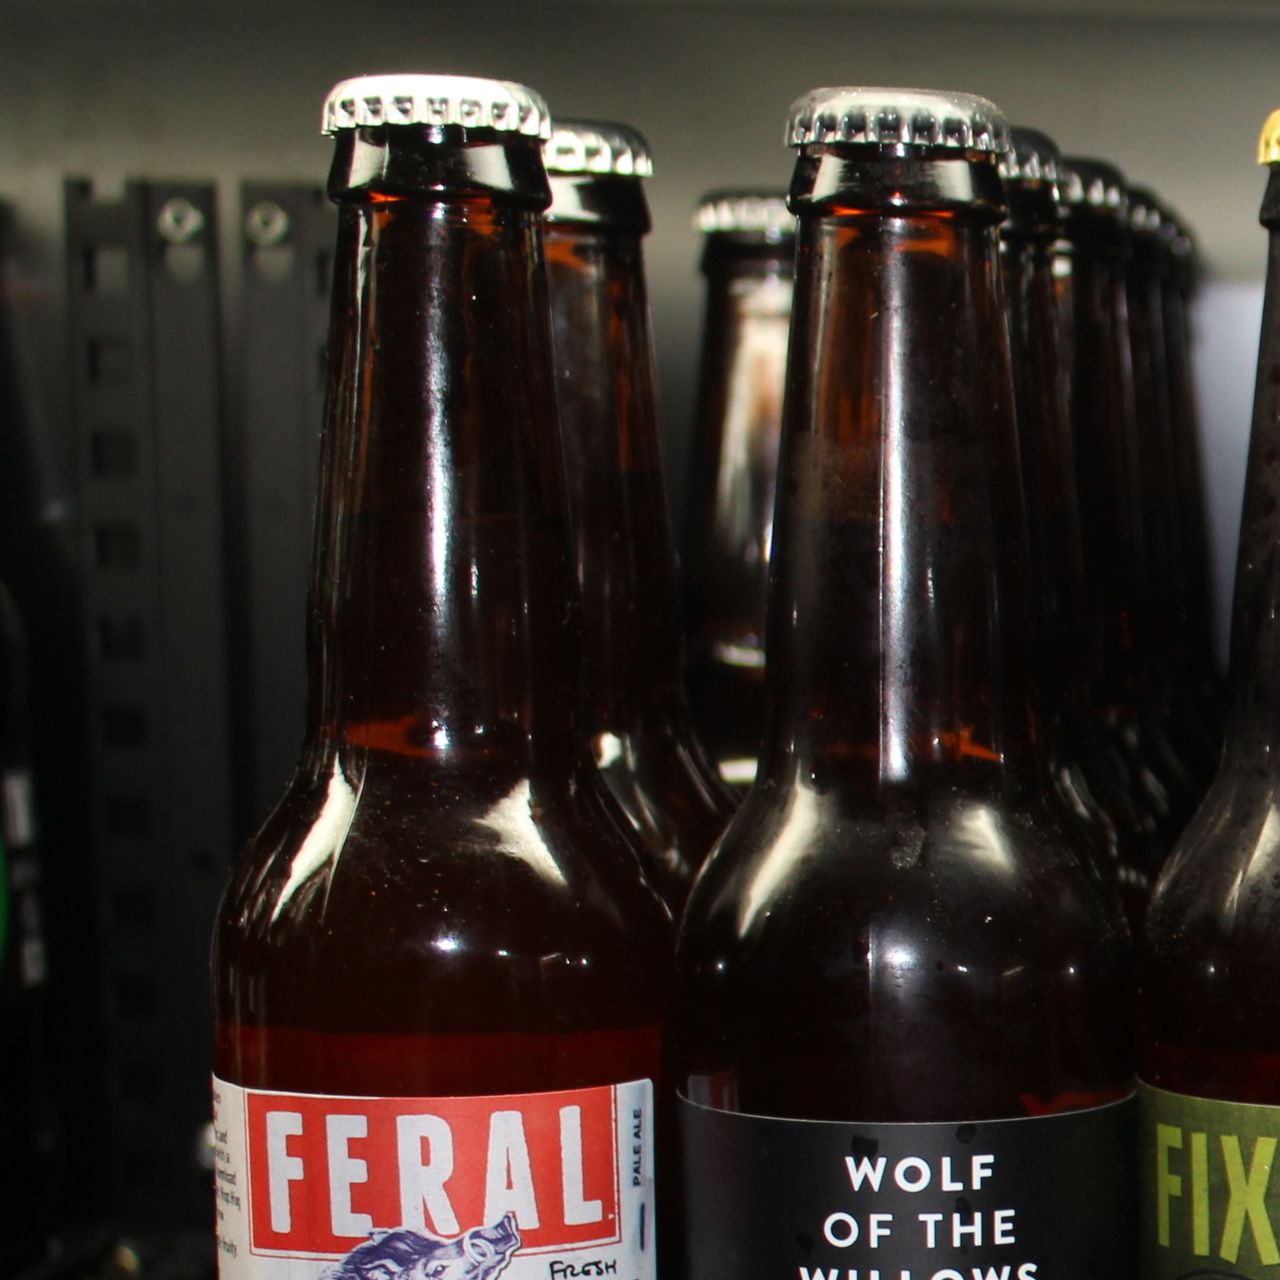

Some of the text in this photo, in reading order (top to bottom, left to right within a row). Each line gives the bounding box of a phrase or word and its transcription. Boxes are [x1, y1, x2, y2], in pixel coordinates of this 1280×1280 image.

[266, 1104, 602, 1238] FERAL
[633, 1108, 643, 1187] PALE ALE
[845, 1154, 995, 1193] WOLF
[823, 1209, 1016, 1249] OF THE
